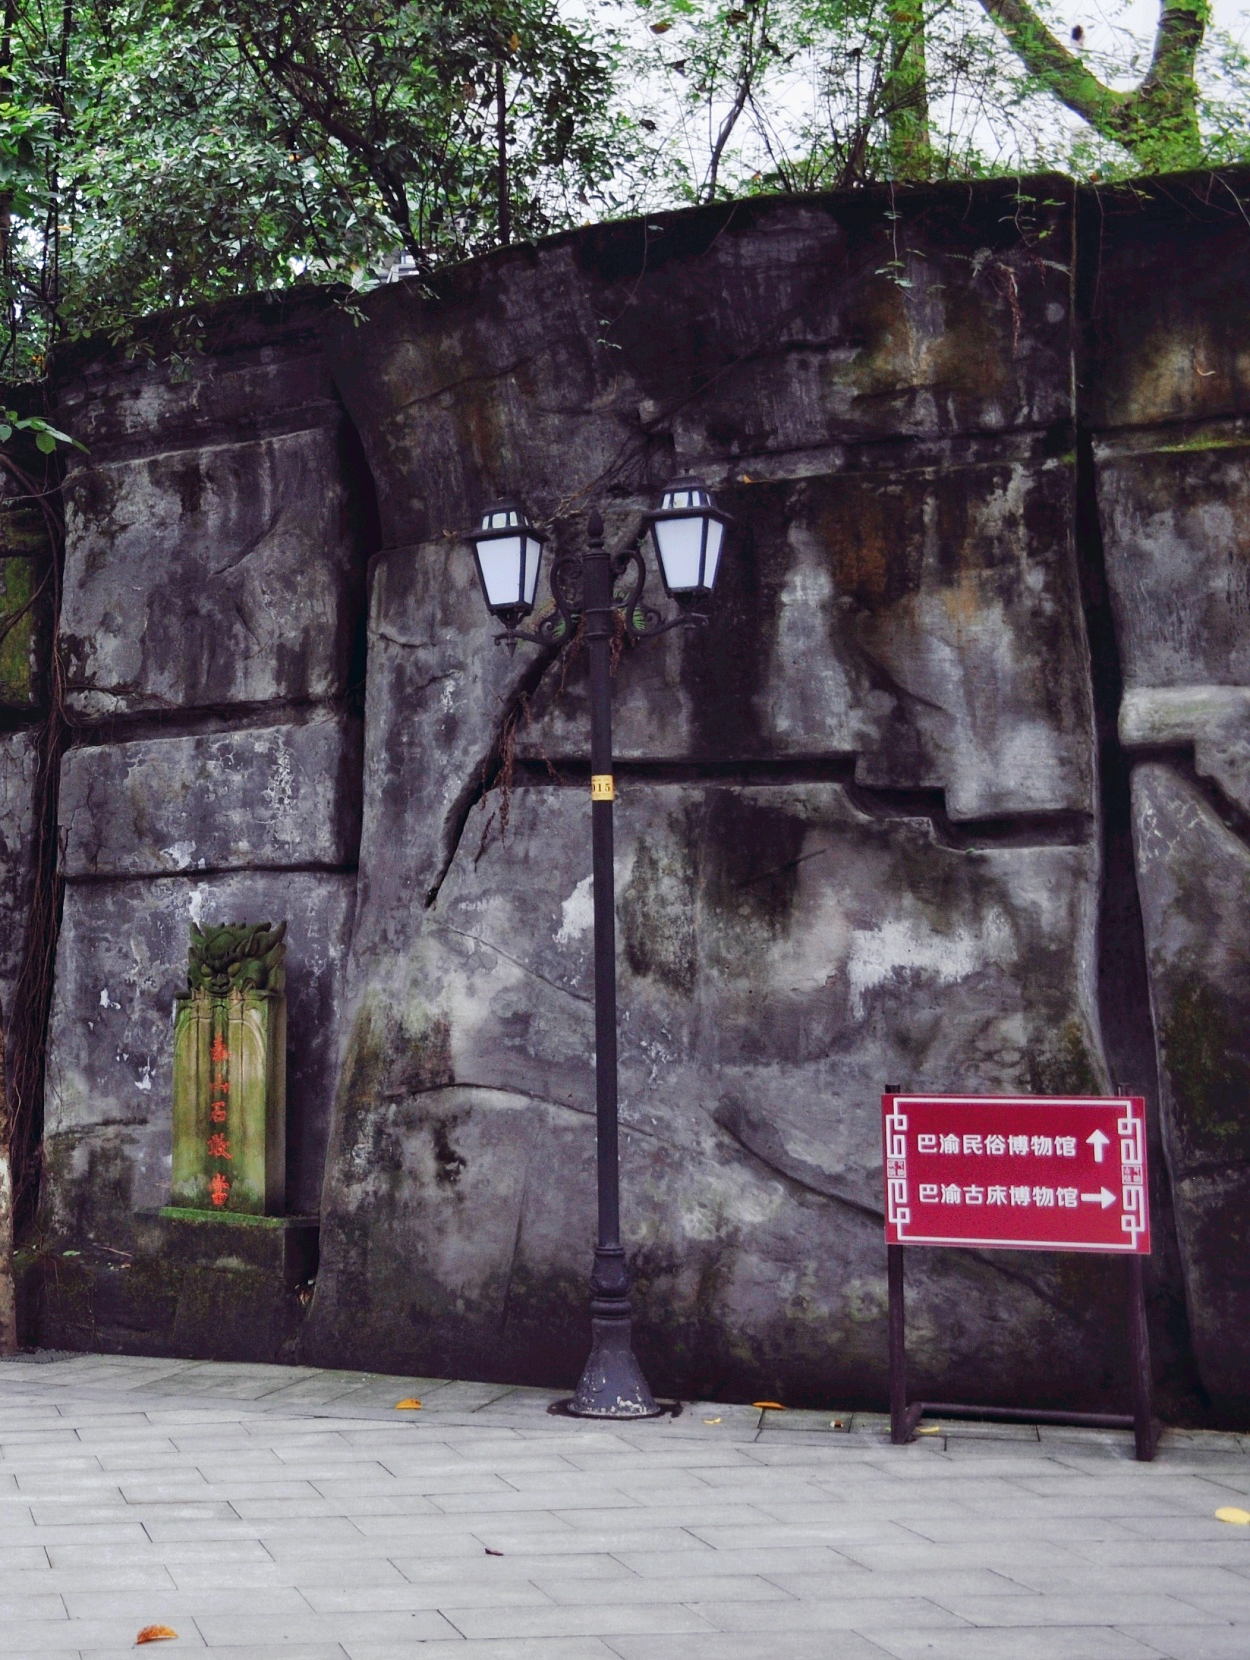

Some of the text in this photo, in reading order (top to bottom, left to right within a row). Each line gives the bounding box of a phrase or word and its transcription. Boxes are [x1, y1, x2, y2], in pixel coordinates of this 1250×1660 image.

[917, 1133, 1076, 1157] 巴渝民俗博物馆
[919, 1183, 1078, 1208] 巴渝古床博物馆
